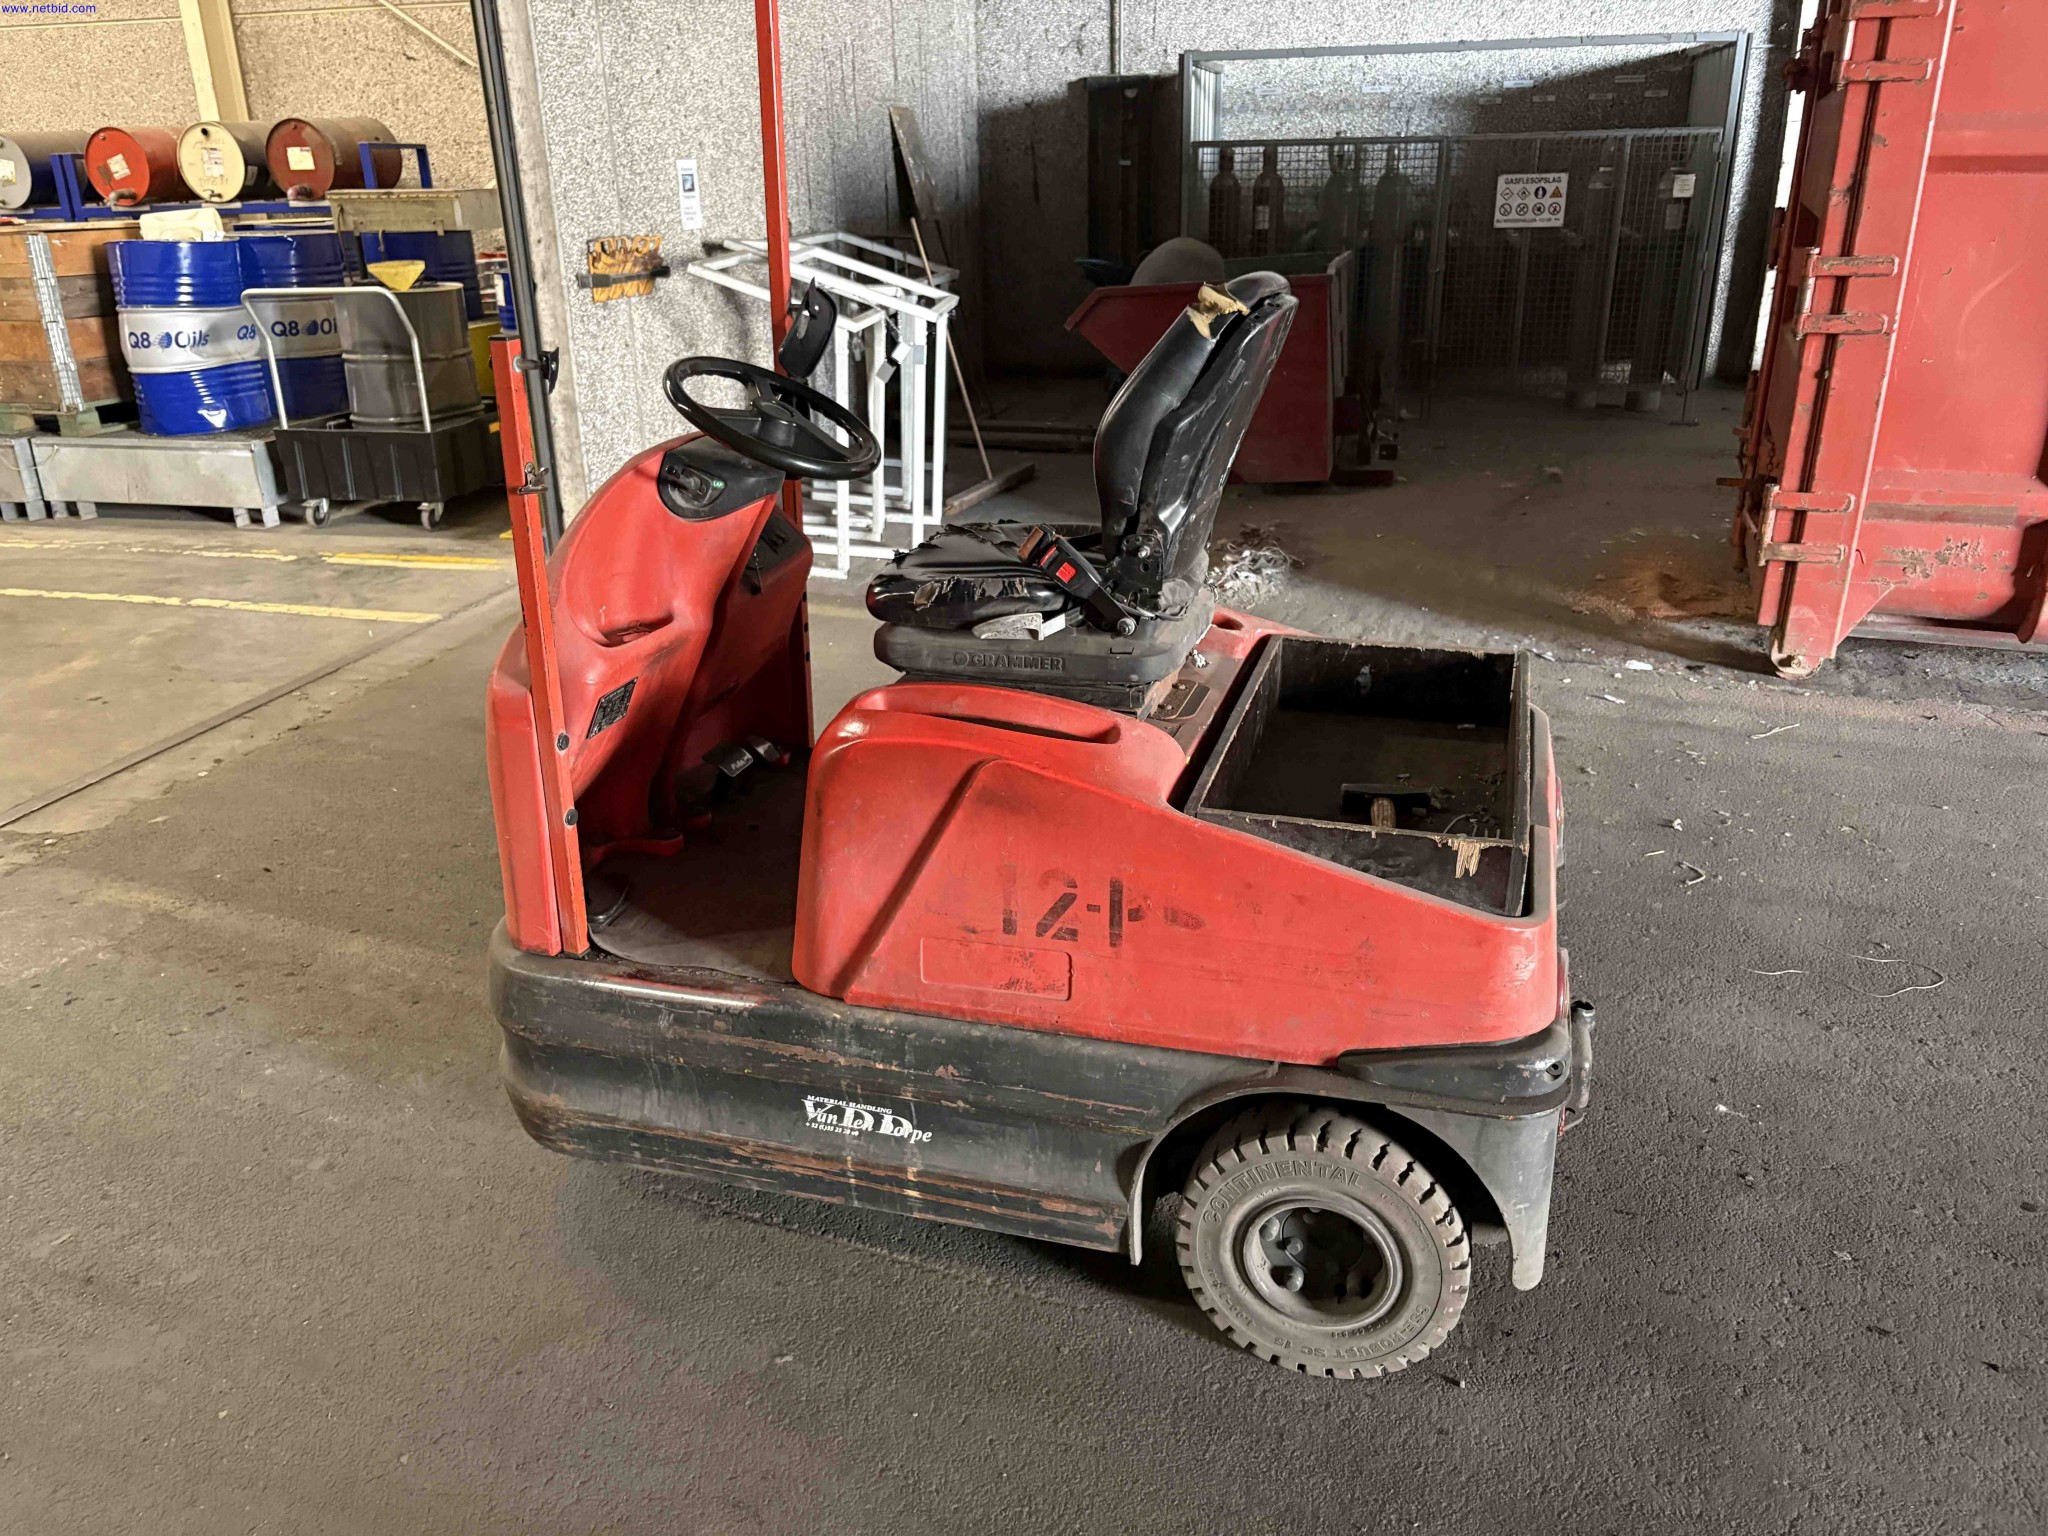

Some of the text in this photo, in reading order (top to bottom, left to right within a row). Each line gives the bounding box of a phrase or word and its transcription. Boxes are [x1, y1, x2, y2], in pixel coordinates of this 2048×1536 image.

[1504, 175, 1562, 185] GASFLESOPSLAG
[237, 324, 257, 340] Q8
[271, 317, 338, 337] Q8 Oi
[128, 331, 211, 350] Q8 Oils
[971, 651, 1064, 671] GRAMMER
[807, 1094, 893, 1115] MATERIAL HANDLING
[1202, 1159, 1364, 1226] CONTINENTAL
